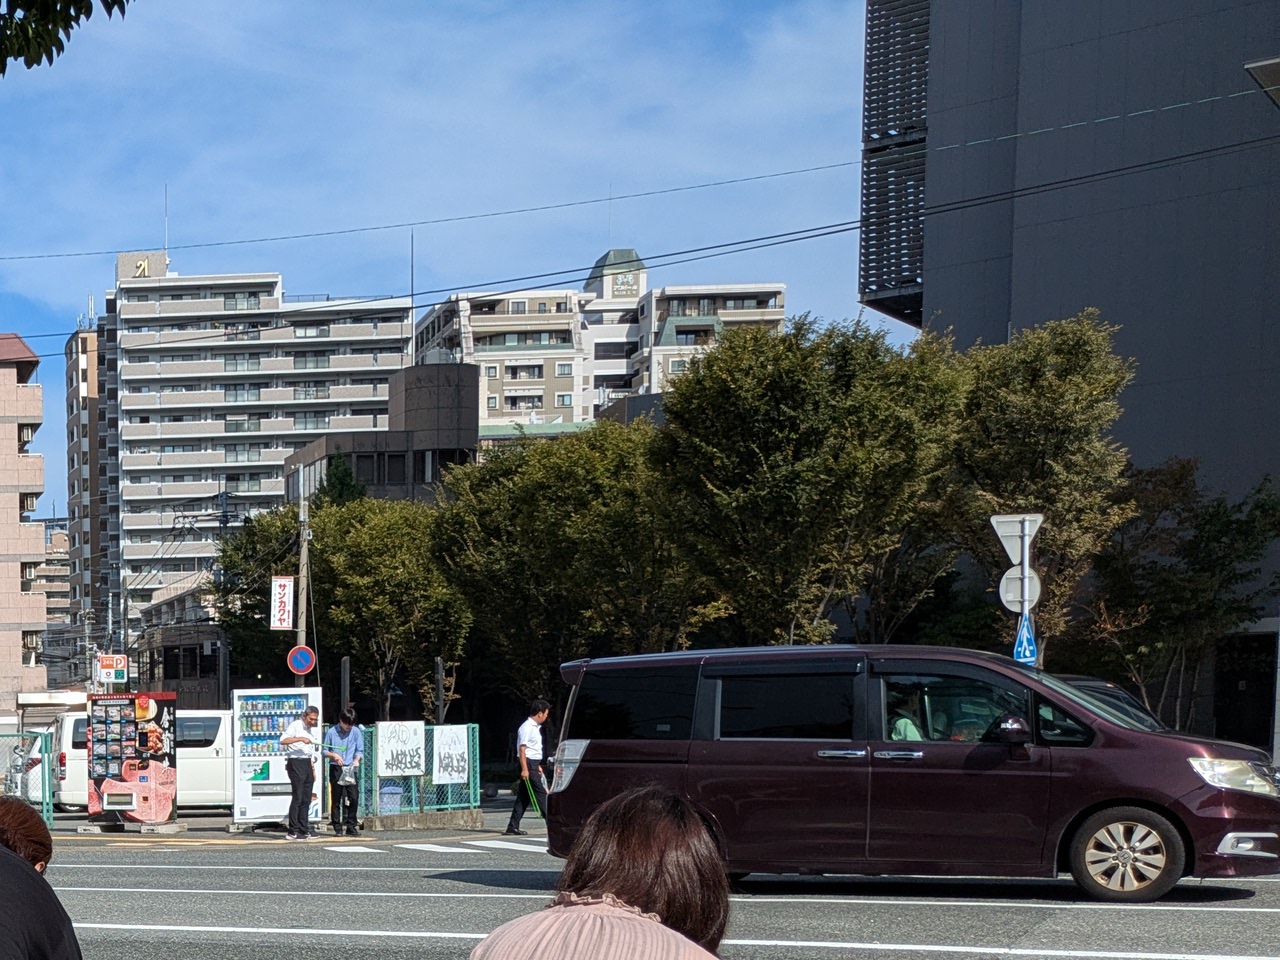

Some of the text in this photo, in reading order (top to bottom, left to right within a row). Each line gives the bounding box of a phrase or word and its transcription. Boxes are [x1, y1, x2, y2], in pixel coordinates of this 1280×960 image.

[277, 583, 287, 626] サンカクヤ
